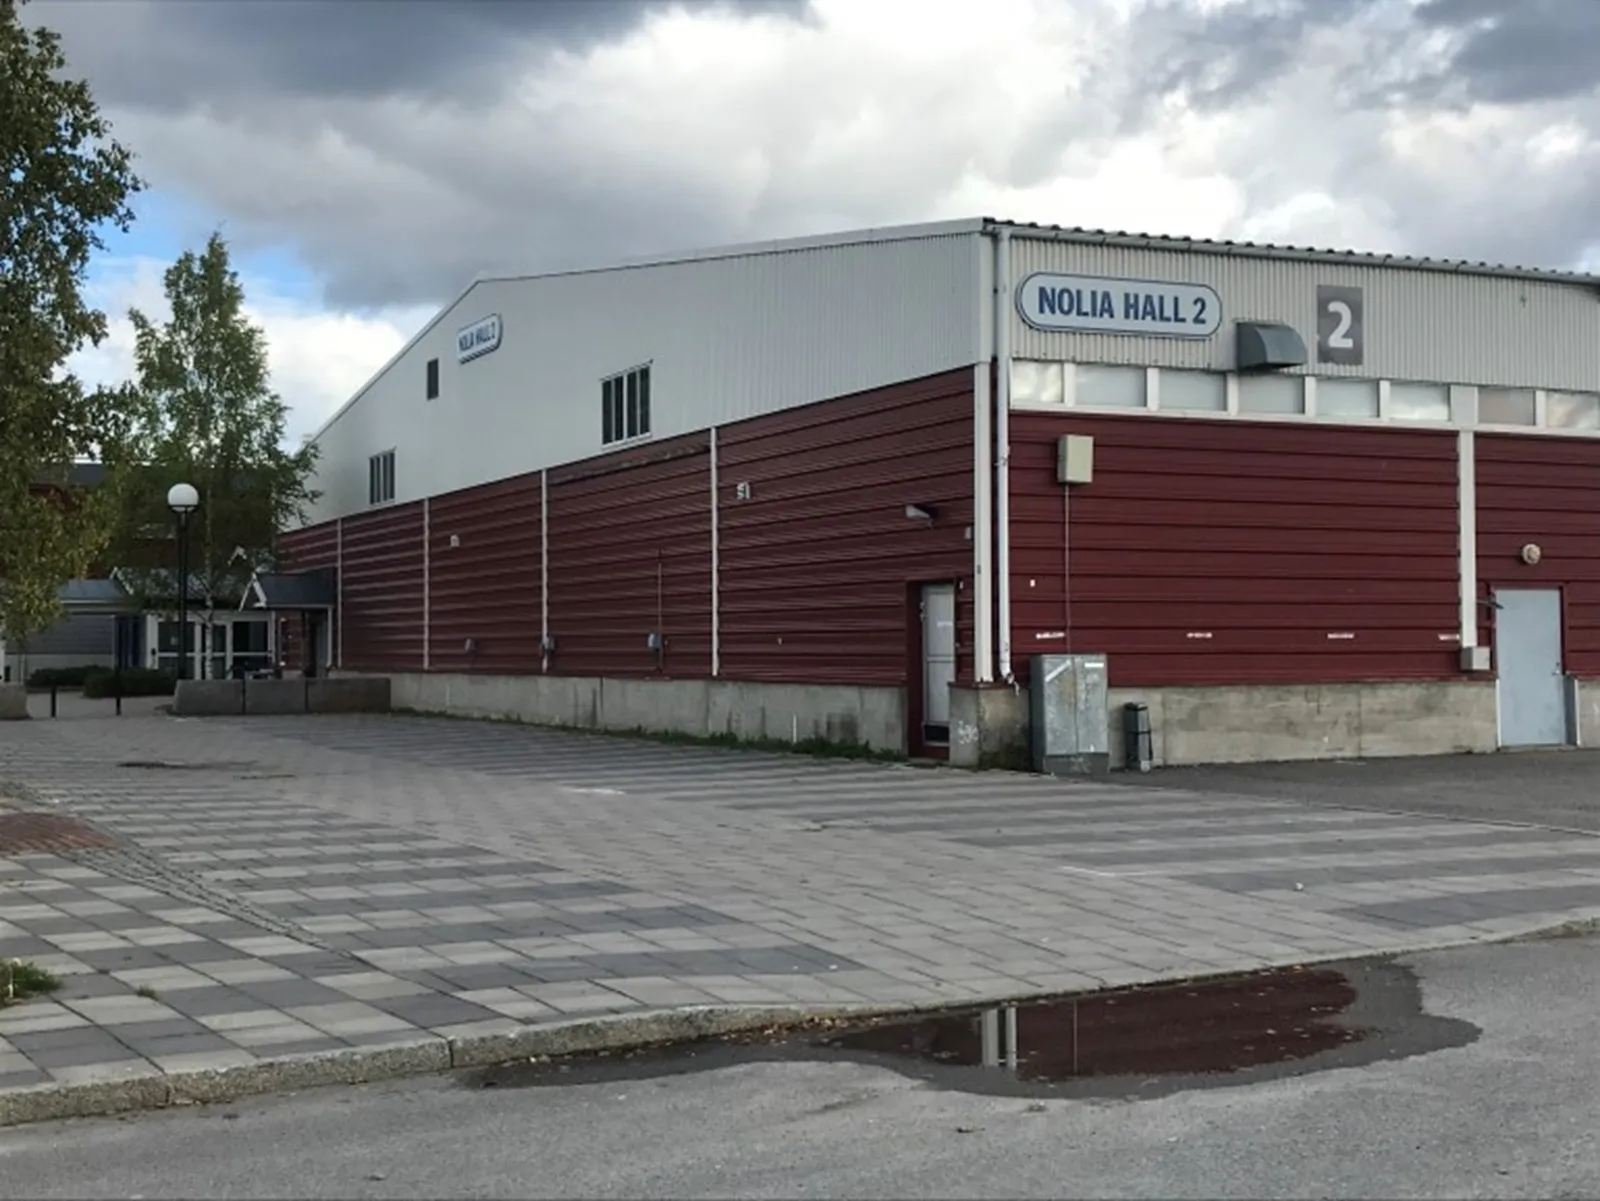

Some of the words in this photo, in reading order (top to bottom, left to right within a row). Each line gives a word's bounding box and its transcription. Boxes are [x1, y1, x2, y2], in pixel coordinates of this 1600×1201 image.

[1038, 286, 1114, 319] NOLIA
[1123, 292, 1187, 323] HALL
[1192, 297, 1207, 325] 2
[1327, 300, 1354, 349] 2
